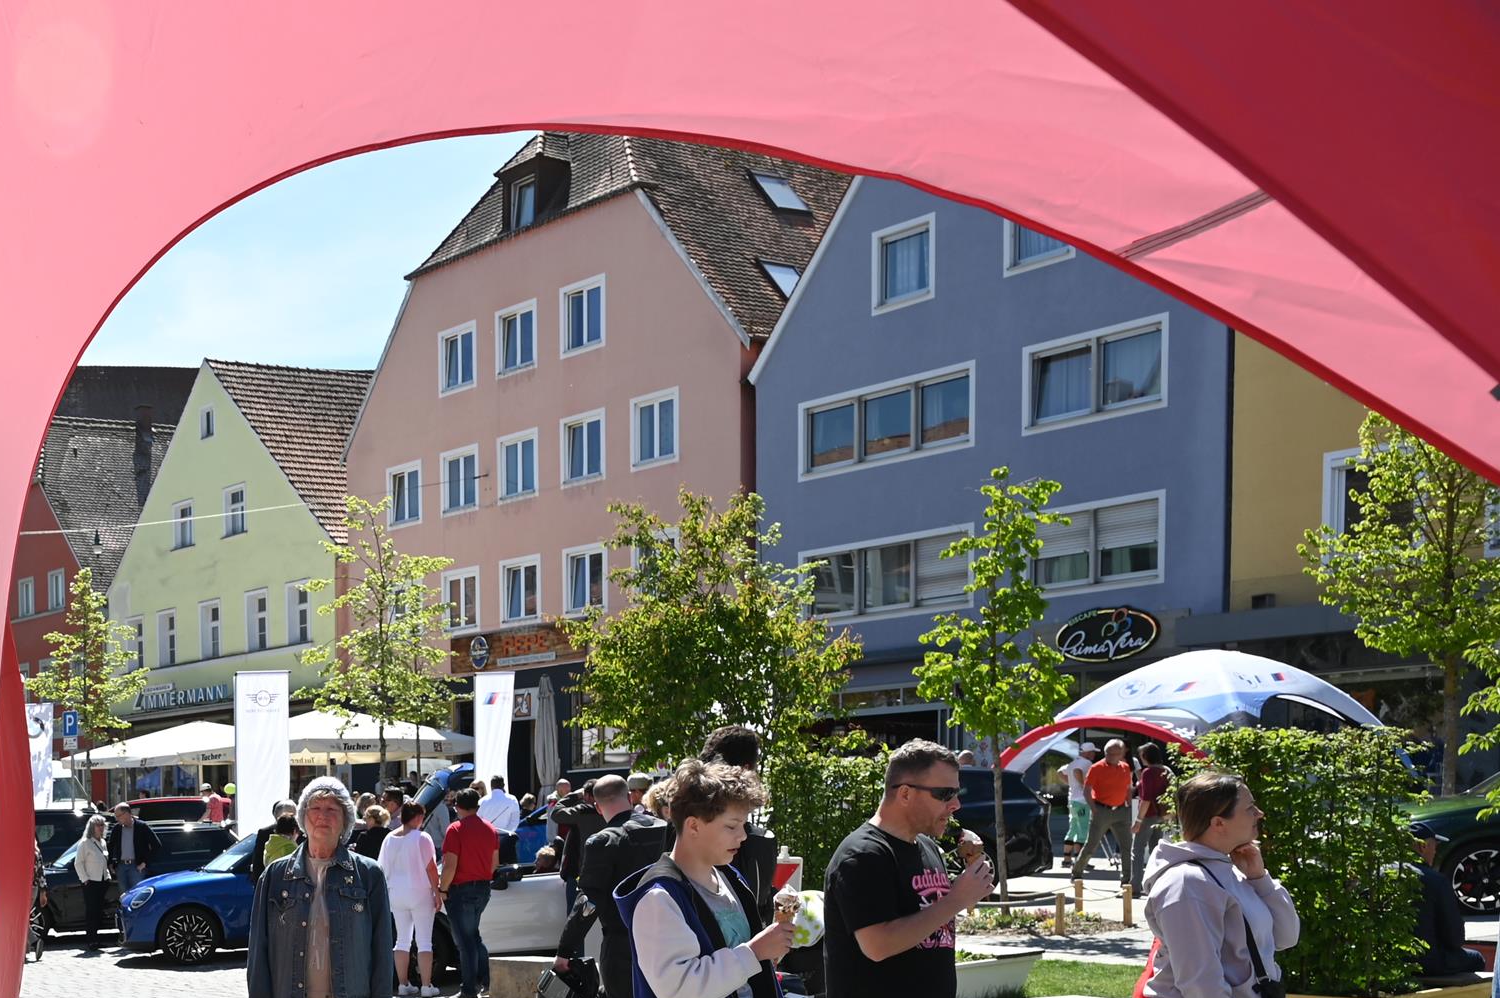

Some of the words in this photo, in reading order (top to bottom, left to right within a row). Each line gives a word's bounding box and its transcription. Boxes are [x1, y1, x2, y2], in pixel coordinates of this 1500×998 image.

[503, 630, 549, 656] PEPE
[65, 714, 75, 733] P
[342, 742, 372, 751] Tucher
[200, 752, 223, 761] Tucher
[912, 867, 951, 890] adida
